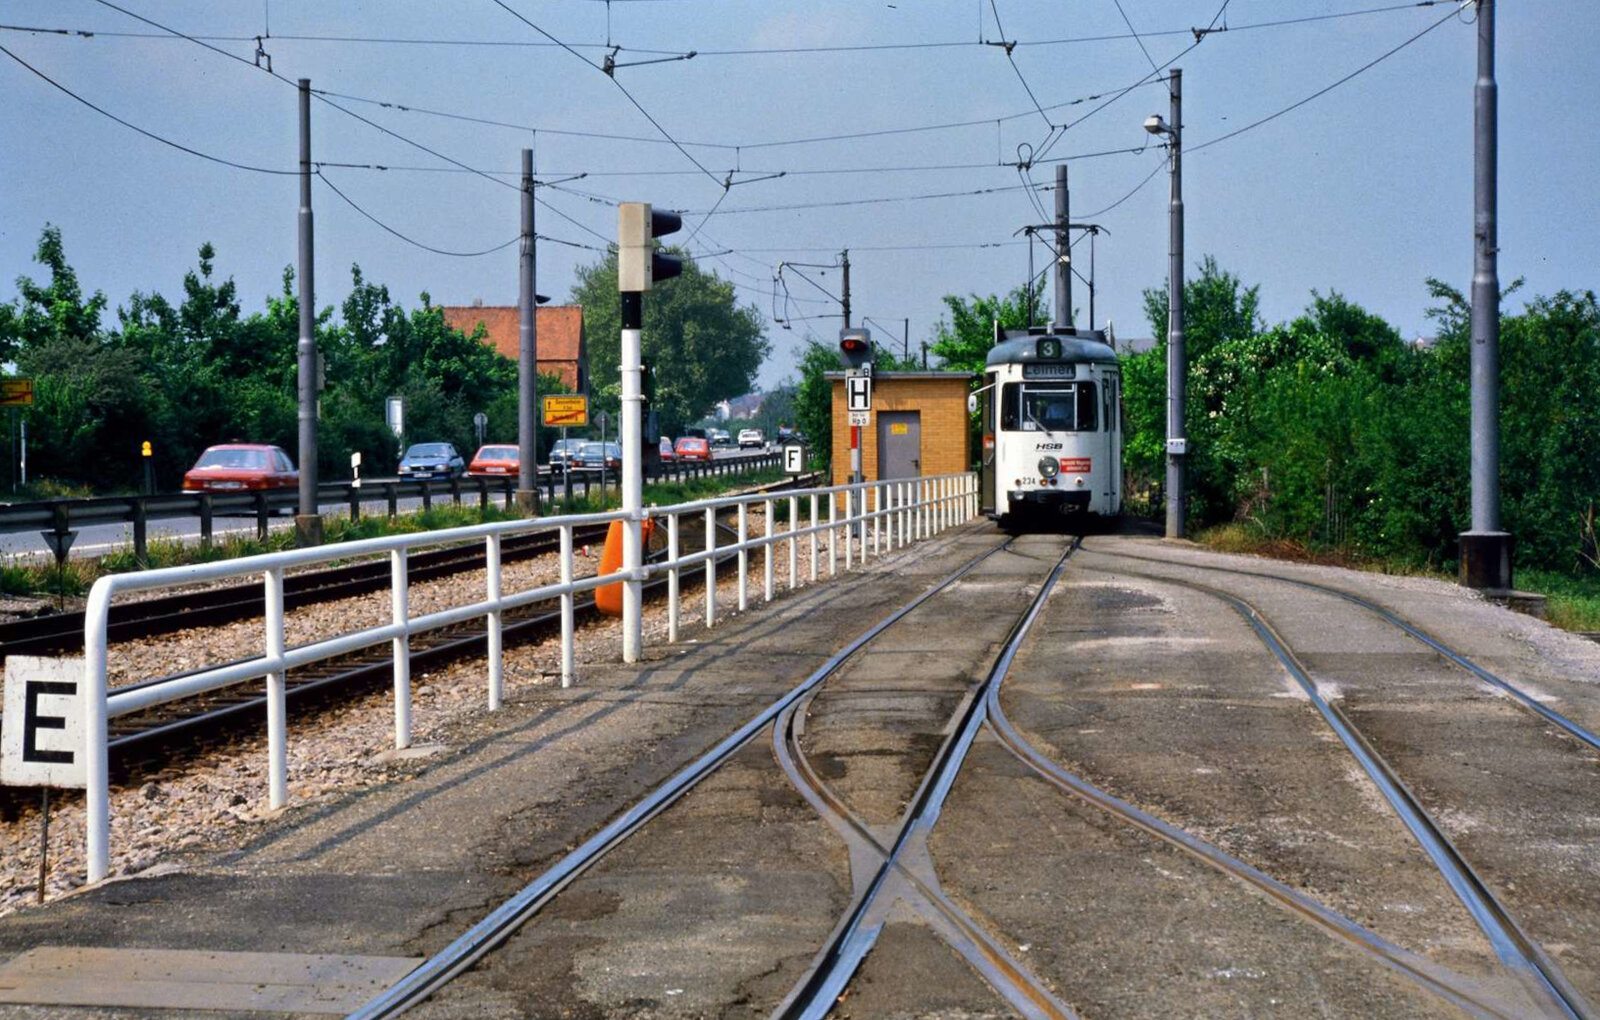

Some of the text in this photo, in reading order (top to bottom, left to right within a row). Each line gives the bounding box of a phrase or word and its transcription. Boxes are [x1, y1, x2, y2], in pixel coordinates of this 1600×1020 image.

[1043, 342, 1054, 356] 3
[1025, 363, 1073, 375] Leimen
[851, 380, 868, 407] H
[788, 450, 799, 468] F
[23, 680, 77, 764] E
